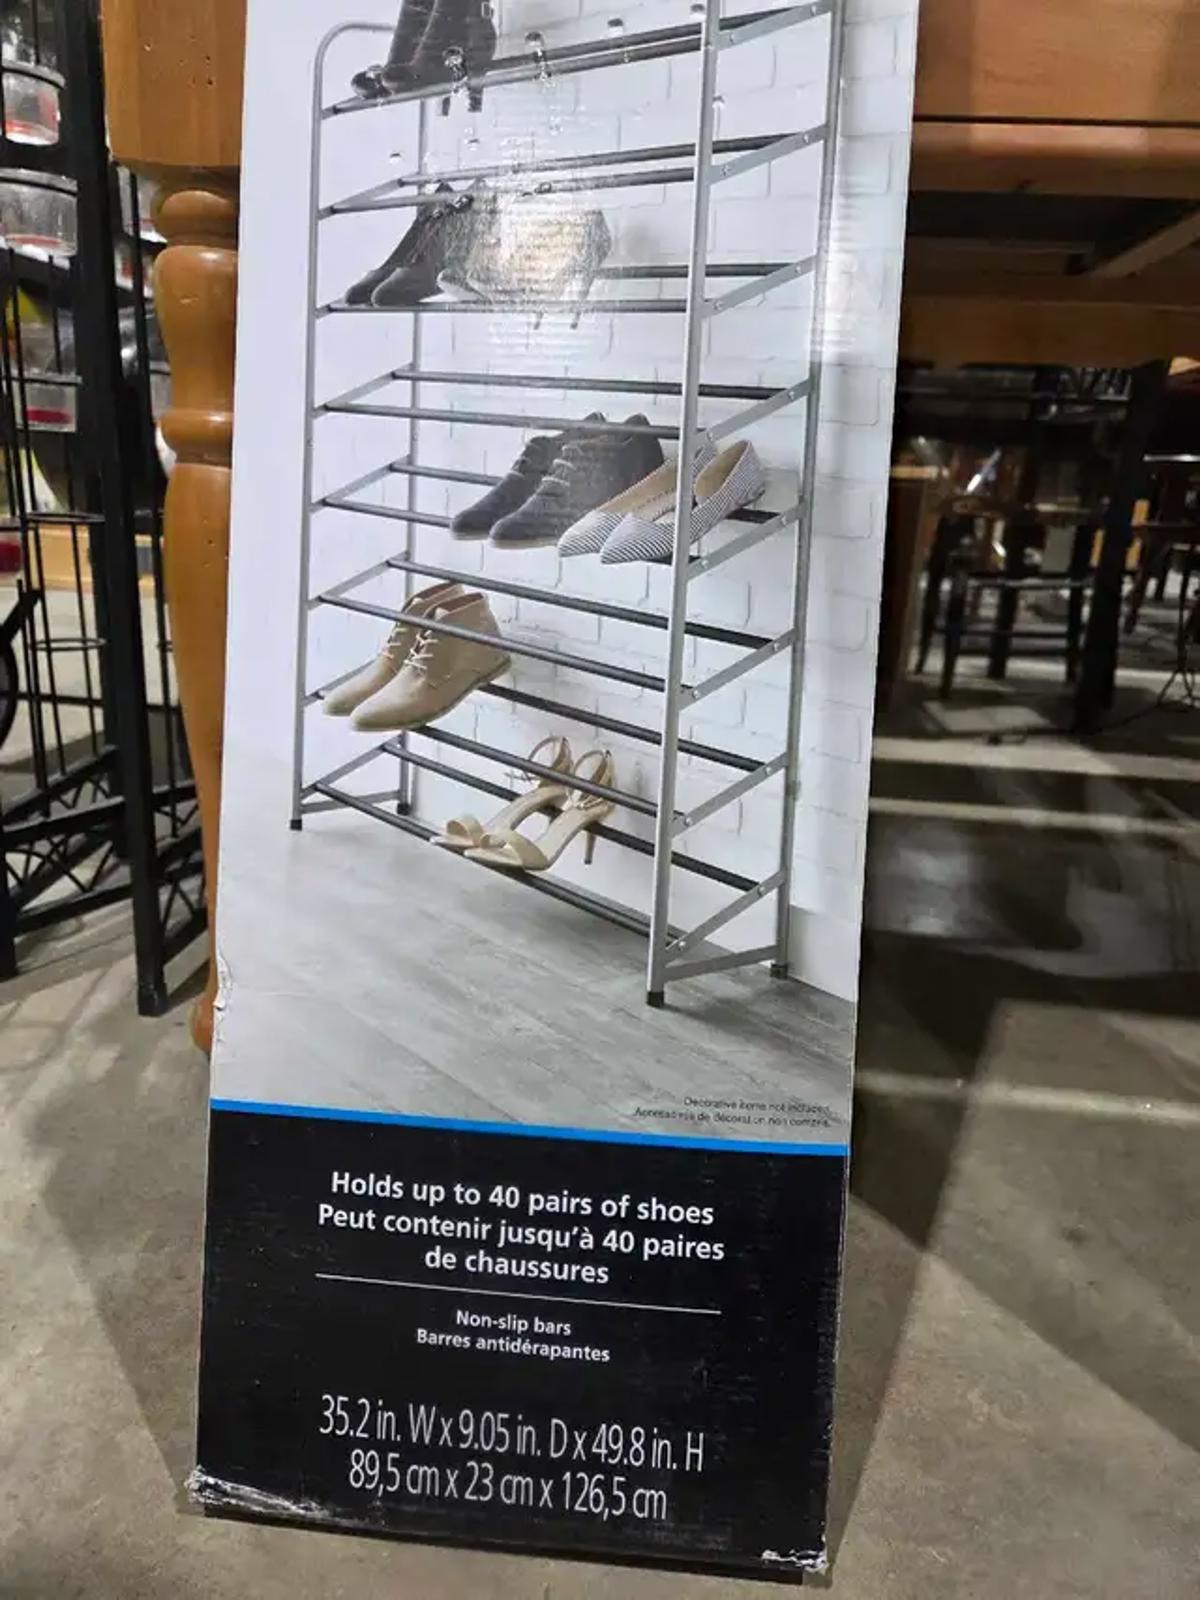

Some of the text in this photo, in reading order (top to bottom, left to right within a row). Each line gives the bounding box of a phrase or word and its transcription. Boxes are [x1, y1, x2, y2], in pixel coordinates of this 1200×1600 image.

[331, 1172, 714, 1225] Holds up to 40 pairs of shoes
[318, 1204, 376, 1230] Peut
[383, 1215, 492, 1240] contenir
[602, 1230, 635, 1253] 40
[643, 1234, 725, 1261] paires
[424, 1245, 609, 1284] de chaussures
[417, 1328, 611, 1362] Barres antidérapantes
[456, 1310, 572, 1336] Non-slip bars
[319, 1395, 704, 1472] 35.2 in. W x 9.05 in. D x 49.8 in. H
[349, 1449, 667, 1521] 89,5 cm x 23 cm x 126,5 cm
